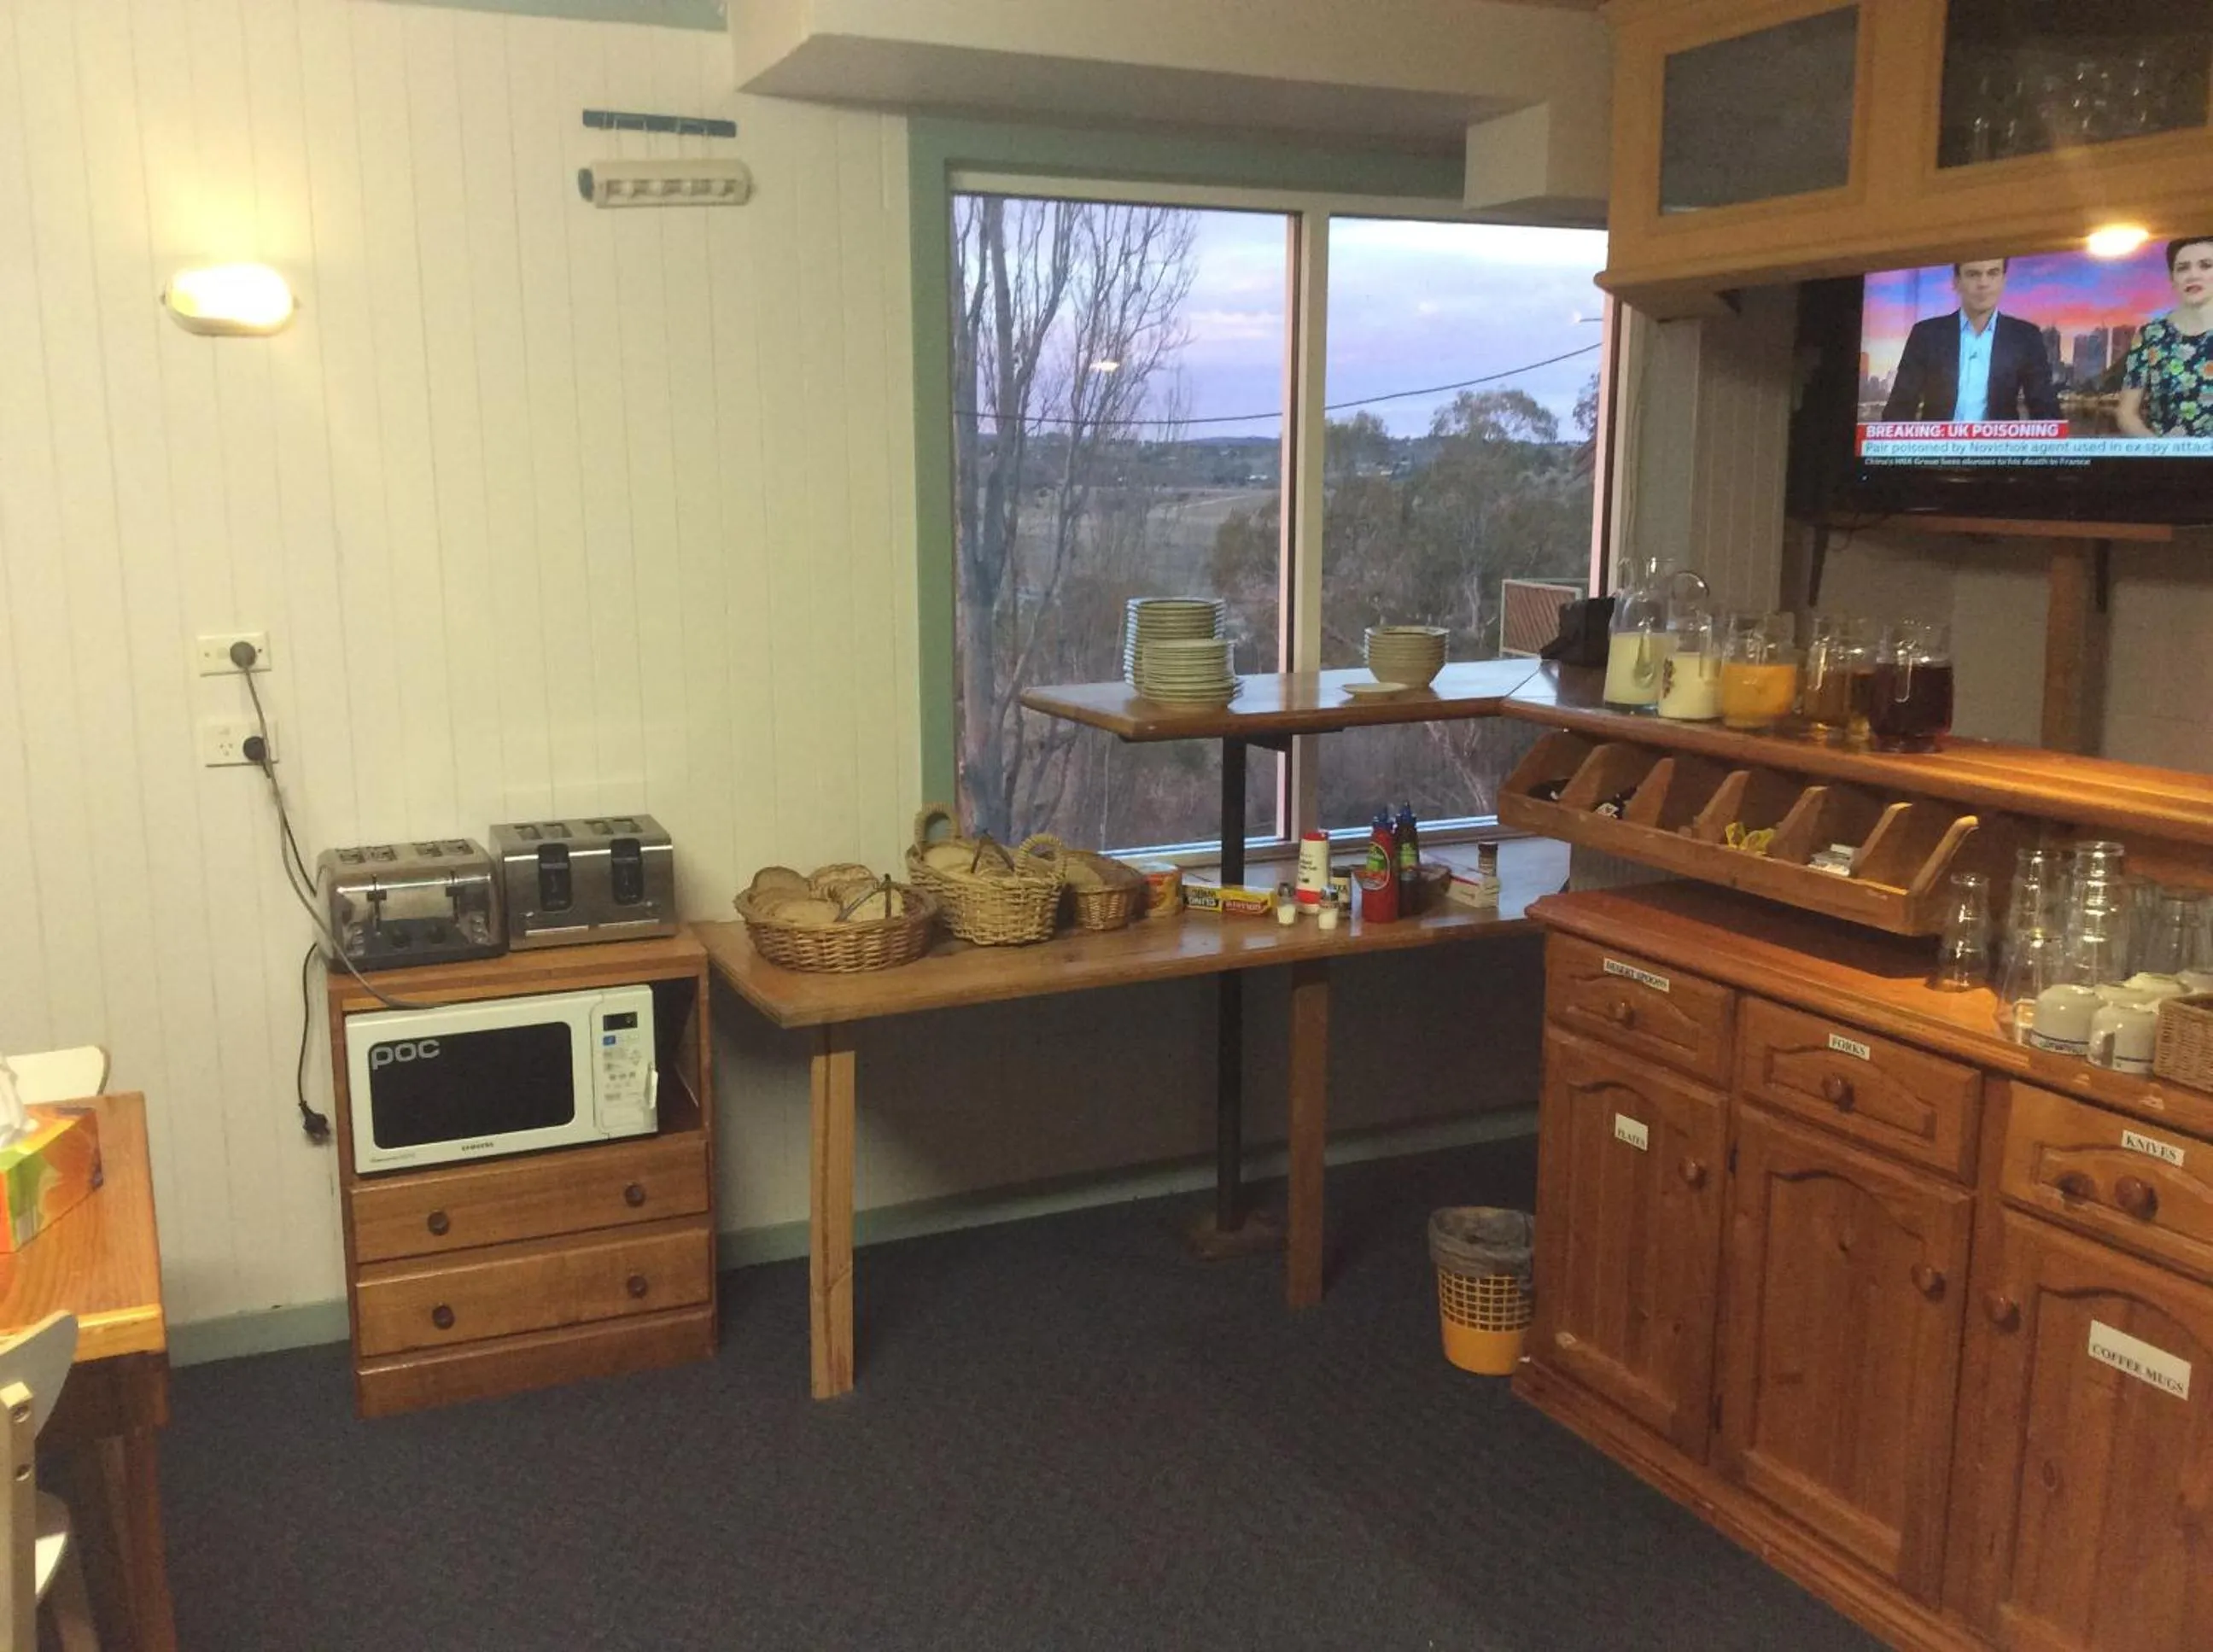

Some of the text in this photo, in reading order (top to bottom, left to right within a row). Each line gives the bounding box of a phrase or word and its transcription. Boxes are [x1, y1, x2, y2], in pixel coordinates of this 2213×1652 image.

[1866, 423, 2059, 438] BREAKING: UK POISONING
[1866, 441, 1889, 452] Pair
[1891, 441, 1948, 454] poisoned
[1951, 441, 1966, 455] by
[1970, 441, 2028, 452] Novichok
[2029, 441, 2070, 455] agent
[2073, 441, 2106, 452] used
[2110, 441, 2122, 452] in
[1831, 1036, 1866, 1056] FORKS
[1617, 1127, 1646, 1149] PLATES
[2126, 1135, 2177, 1160] KNIVES
[2092, 1344, 2184, 1393] COFFEE MUGS
